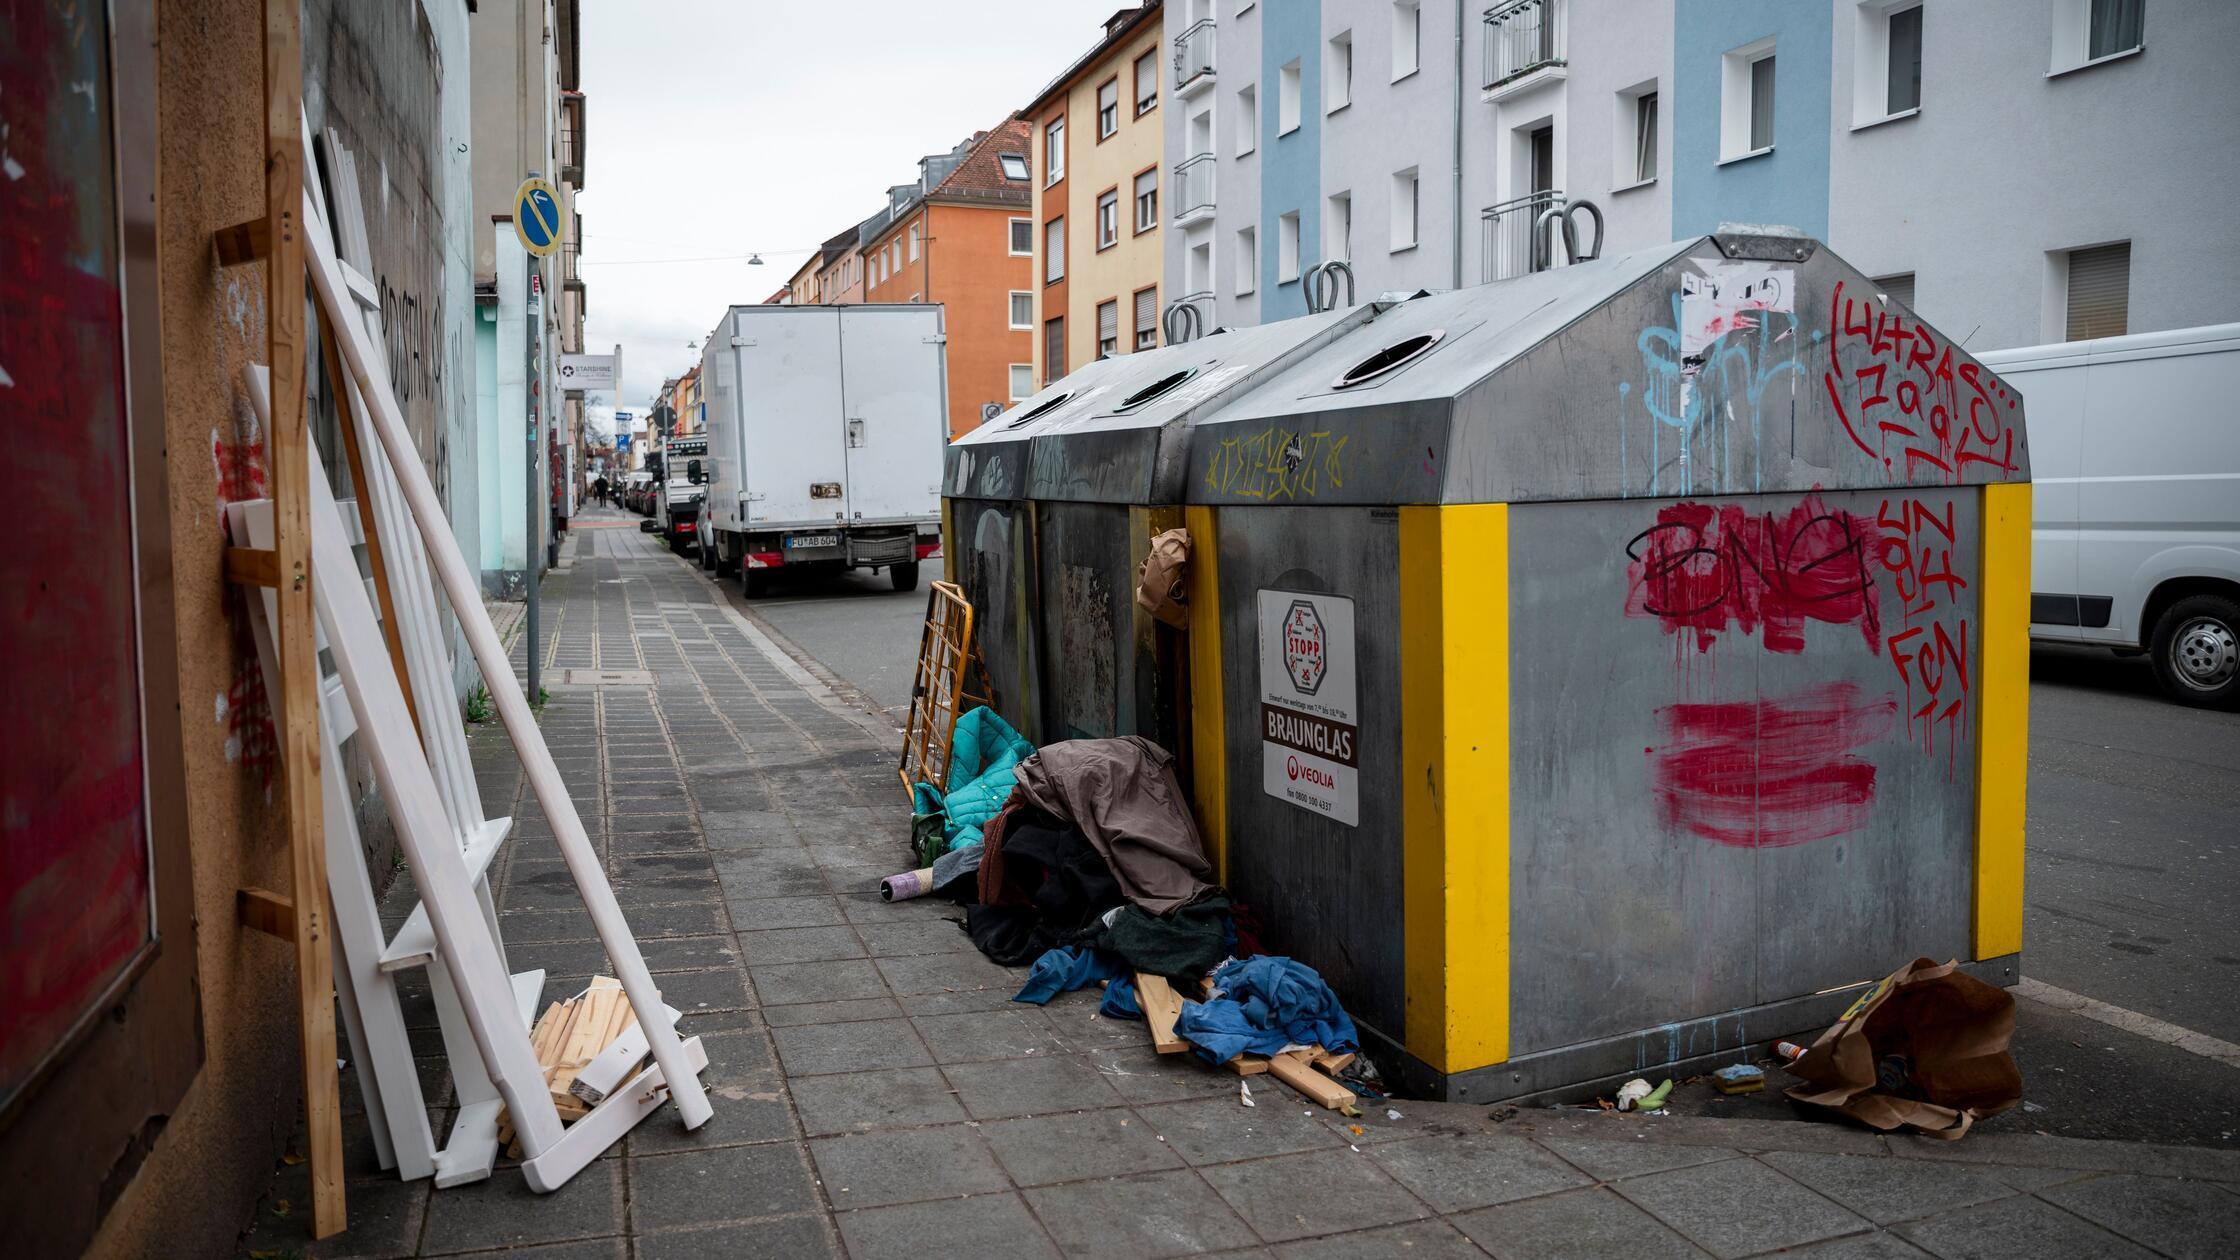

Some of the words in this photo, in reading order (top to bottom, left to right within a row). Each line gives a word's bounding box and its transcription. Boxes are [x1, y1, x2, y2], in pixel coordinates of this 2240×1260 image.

[1844, 298, 2000, 445] ULTRAS
[1289, 637, 1320, 657] STOPP
[1267, 710, 1351, 761] BRAUNGLAS
[1300, 765, 1335, 789] VEOLIA
[1295, 791, 1308, 803] 0800
[1318, 800, 1332, 812] 4337
